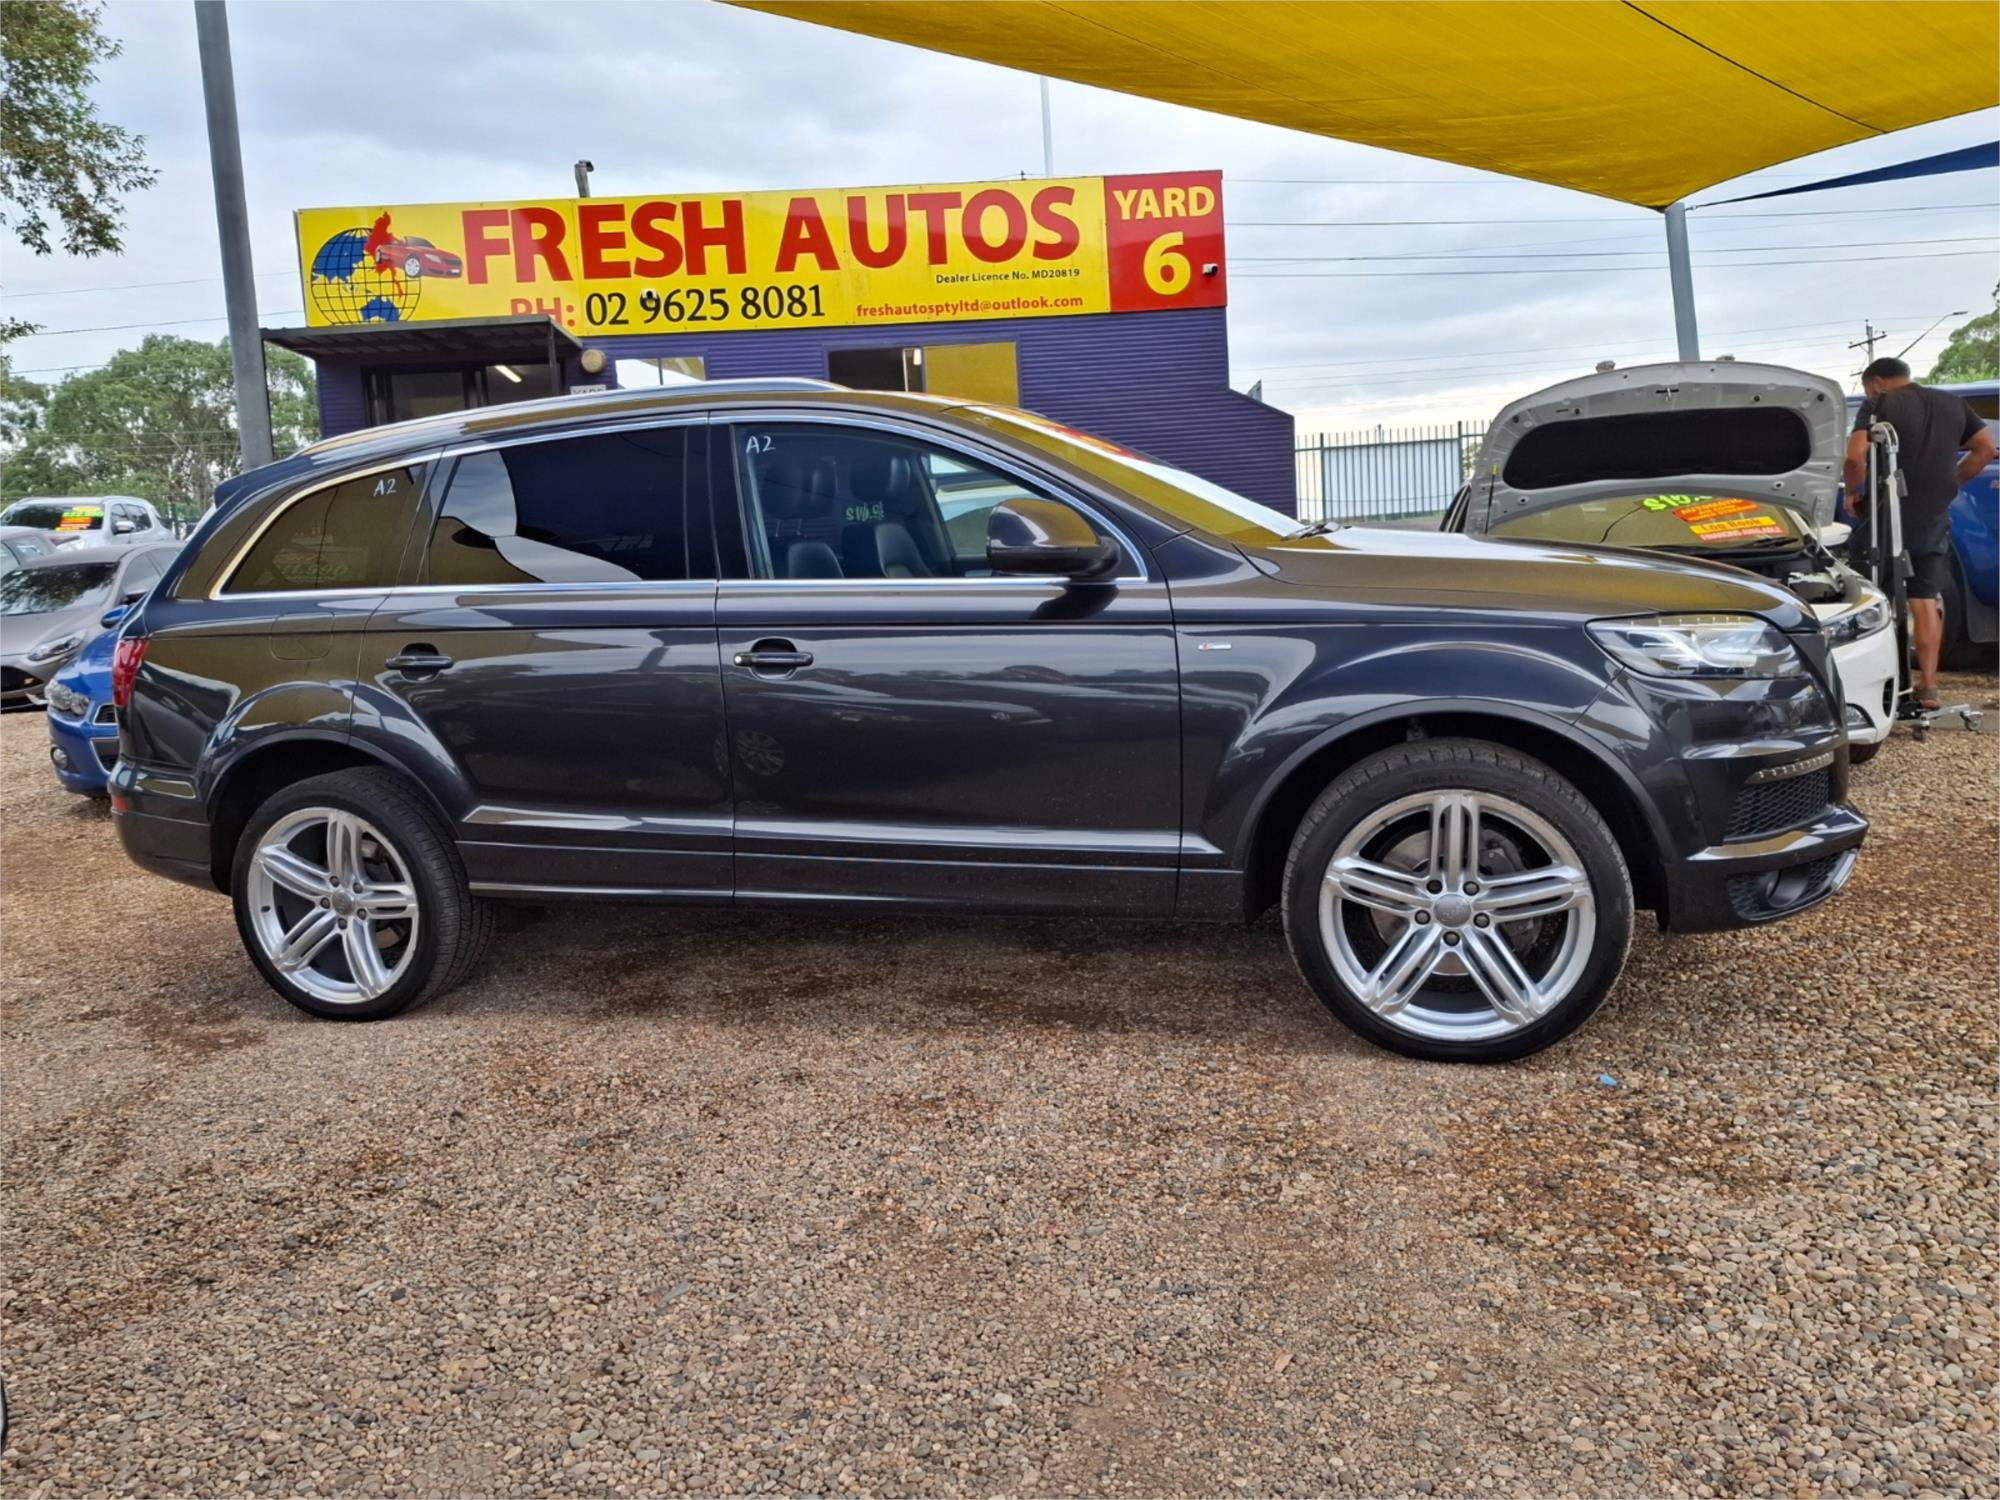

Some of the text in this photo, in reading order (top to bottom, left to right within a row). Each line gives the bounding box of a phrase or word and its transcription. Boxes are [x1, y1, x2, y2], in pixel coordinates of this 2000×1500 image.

[1113, 186, 1215, 220] YARD
[462, 186, 1080, 285] FRESH AUTOS
[936, 268, 1080, 284] Dealer Licence No. MD20819
[1143, 231, 1191, 295] 6
[586, 292, 629, 326] 02
[640, 288, 729, 323] 9625
[740, 284, 825, 320] 8081
[856, 296, 1083, 317] freshautosptyltd@outlook.com
[745, 434, 776, 454] A2
[373, 478, 397, 497] A2
